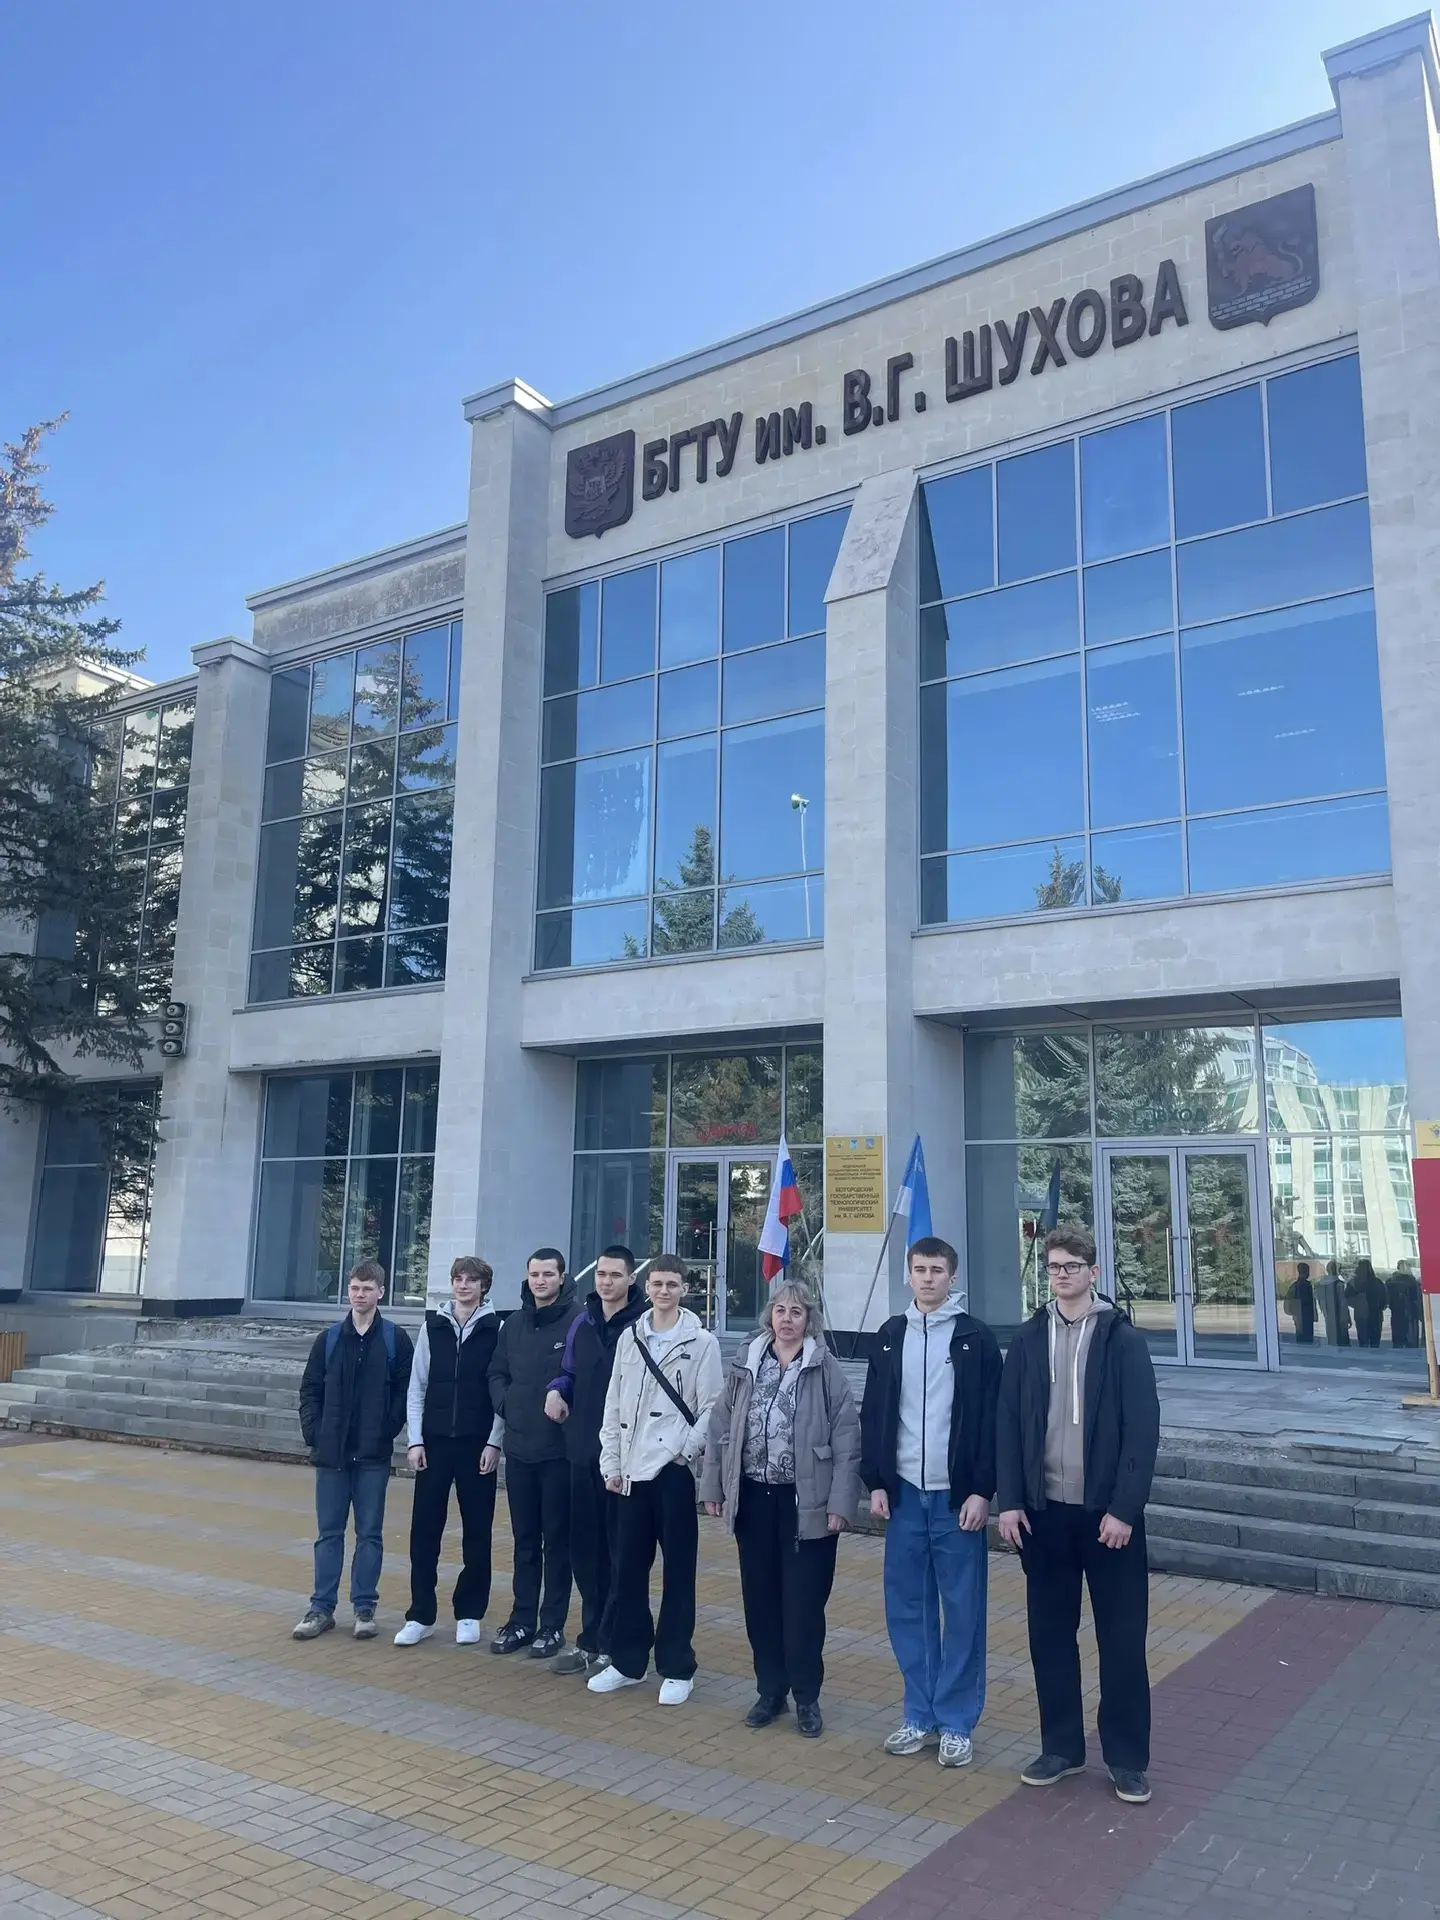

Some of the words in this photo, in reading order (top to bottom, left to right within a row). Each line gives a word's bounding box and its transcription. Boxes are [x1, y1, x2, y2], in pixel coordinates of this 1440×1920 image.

[642, 411, 744, 501] БГТУ
[842, 352, 927, 435] В.Г.
[945, 258, 1189, 403] ШУХОВА
